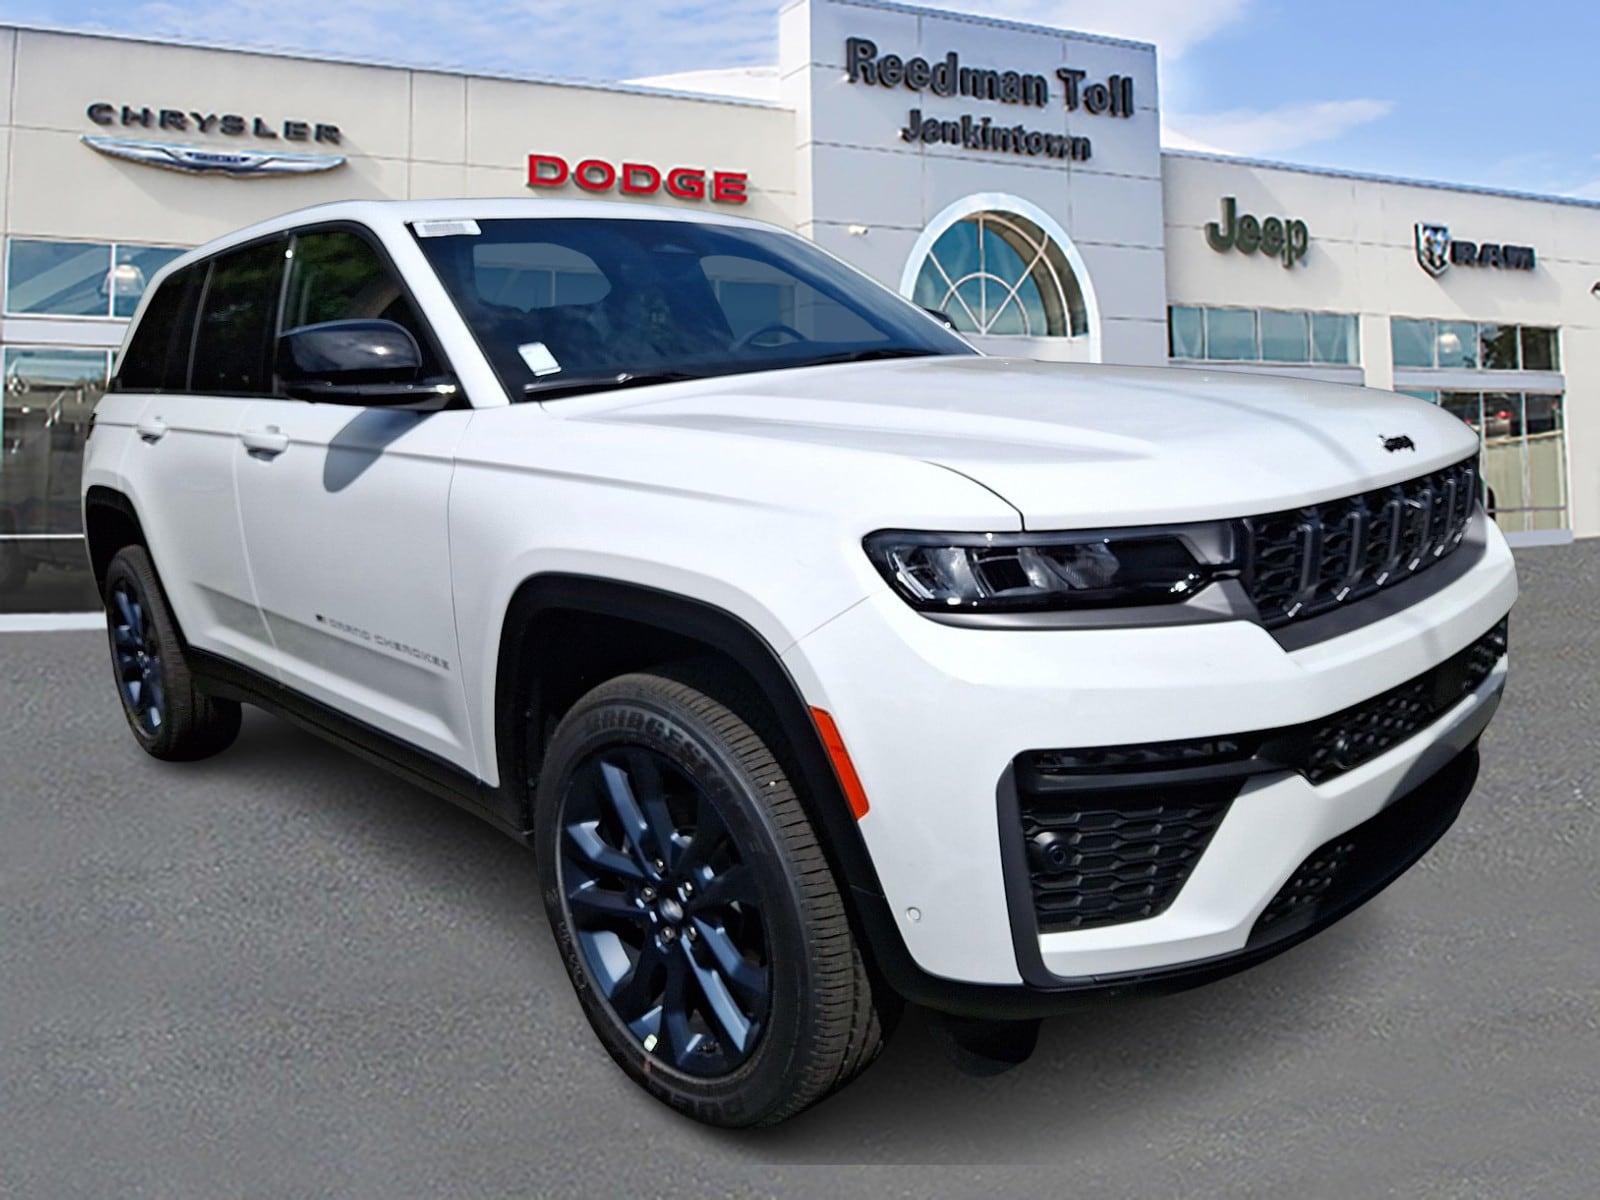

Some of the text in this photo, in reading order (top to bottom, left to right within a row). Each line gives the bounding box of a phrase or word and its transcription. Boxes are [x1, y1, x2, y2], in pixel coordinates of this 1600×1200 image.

[846, 37, 1135, 119] Reedman Toll
[87, 102, 341, 145] CHRYSLER
[901, 109, 1092, 162] Jenkintown
[527, 153, 748, 202] DODGE
[1205, 197, 1308, 269] Jeep
[1450, 240, 1536, 271] RAM
